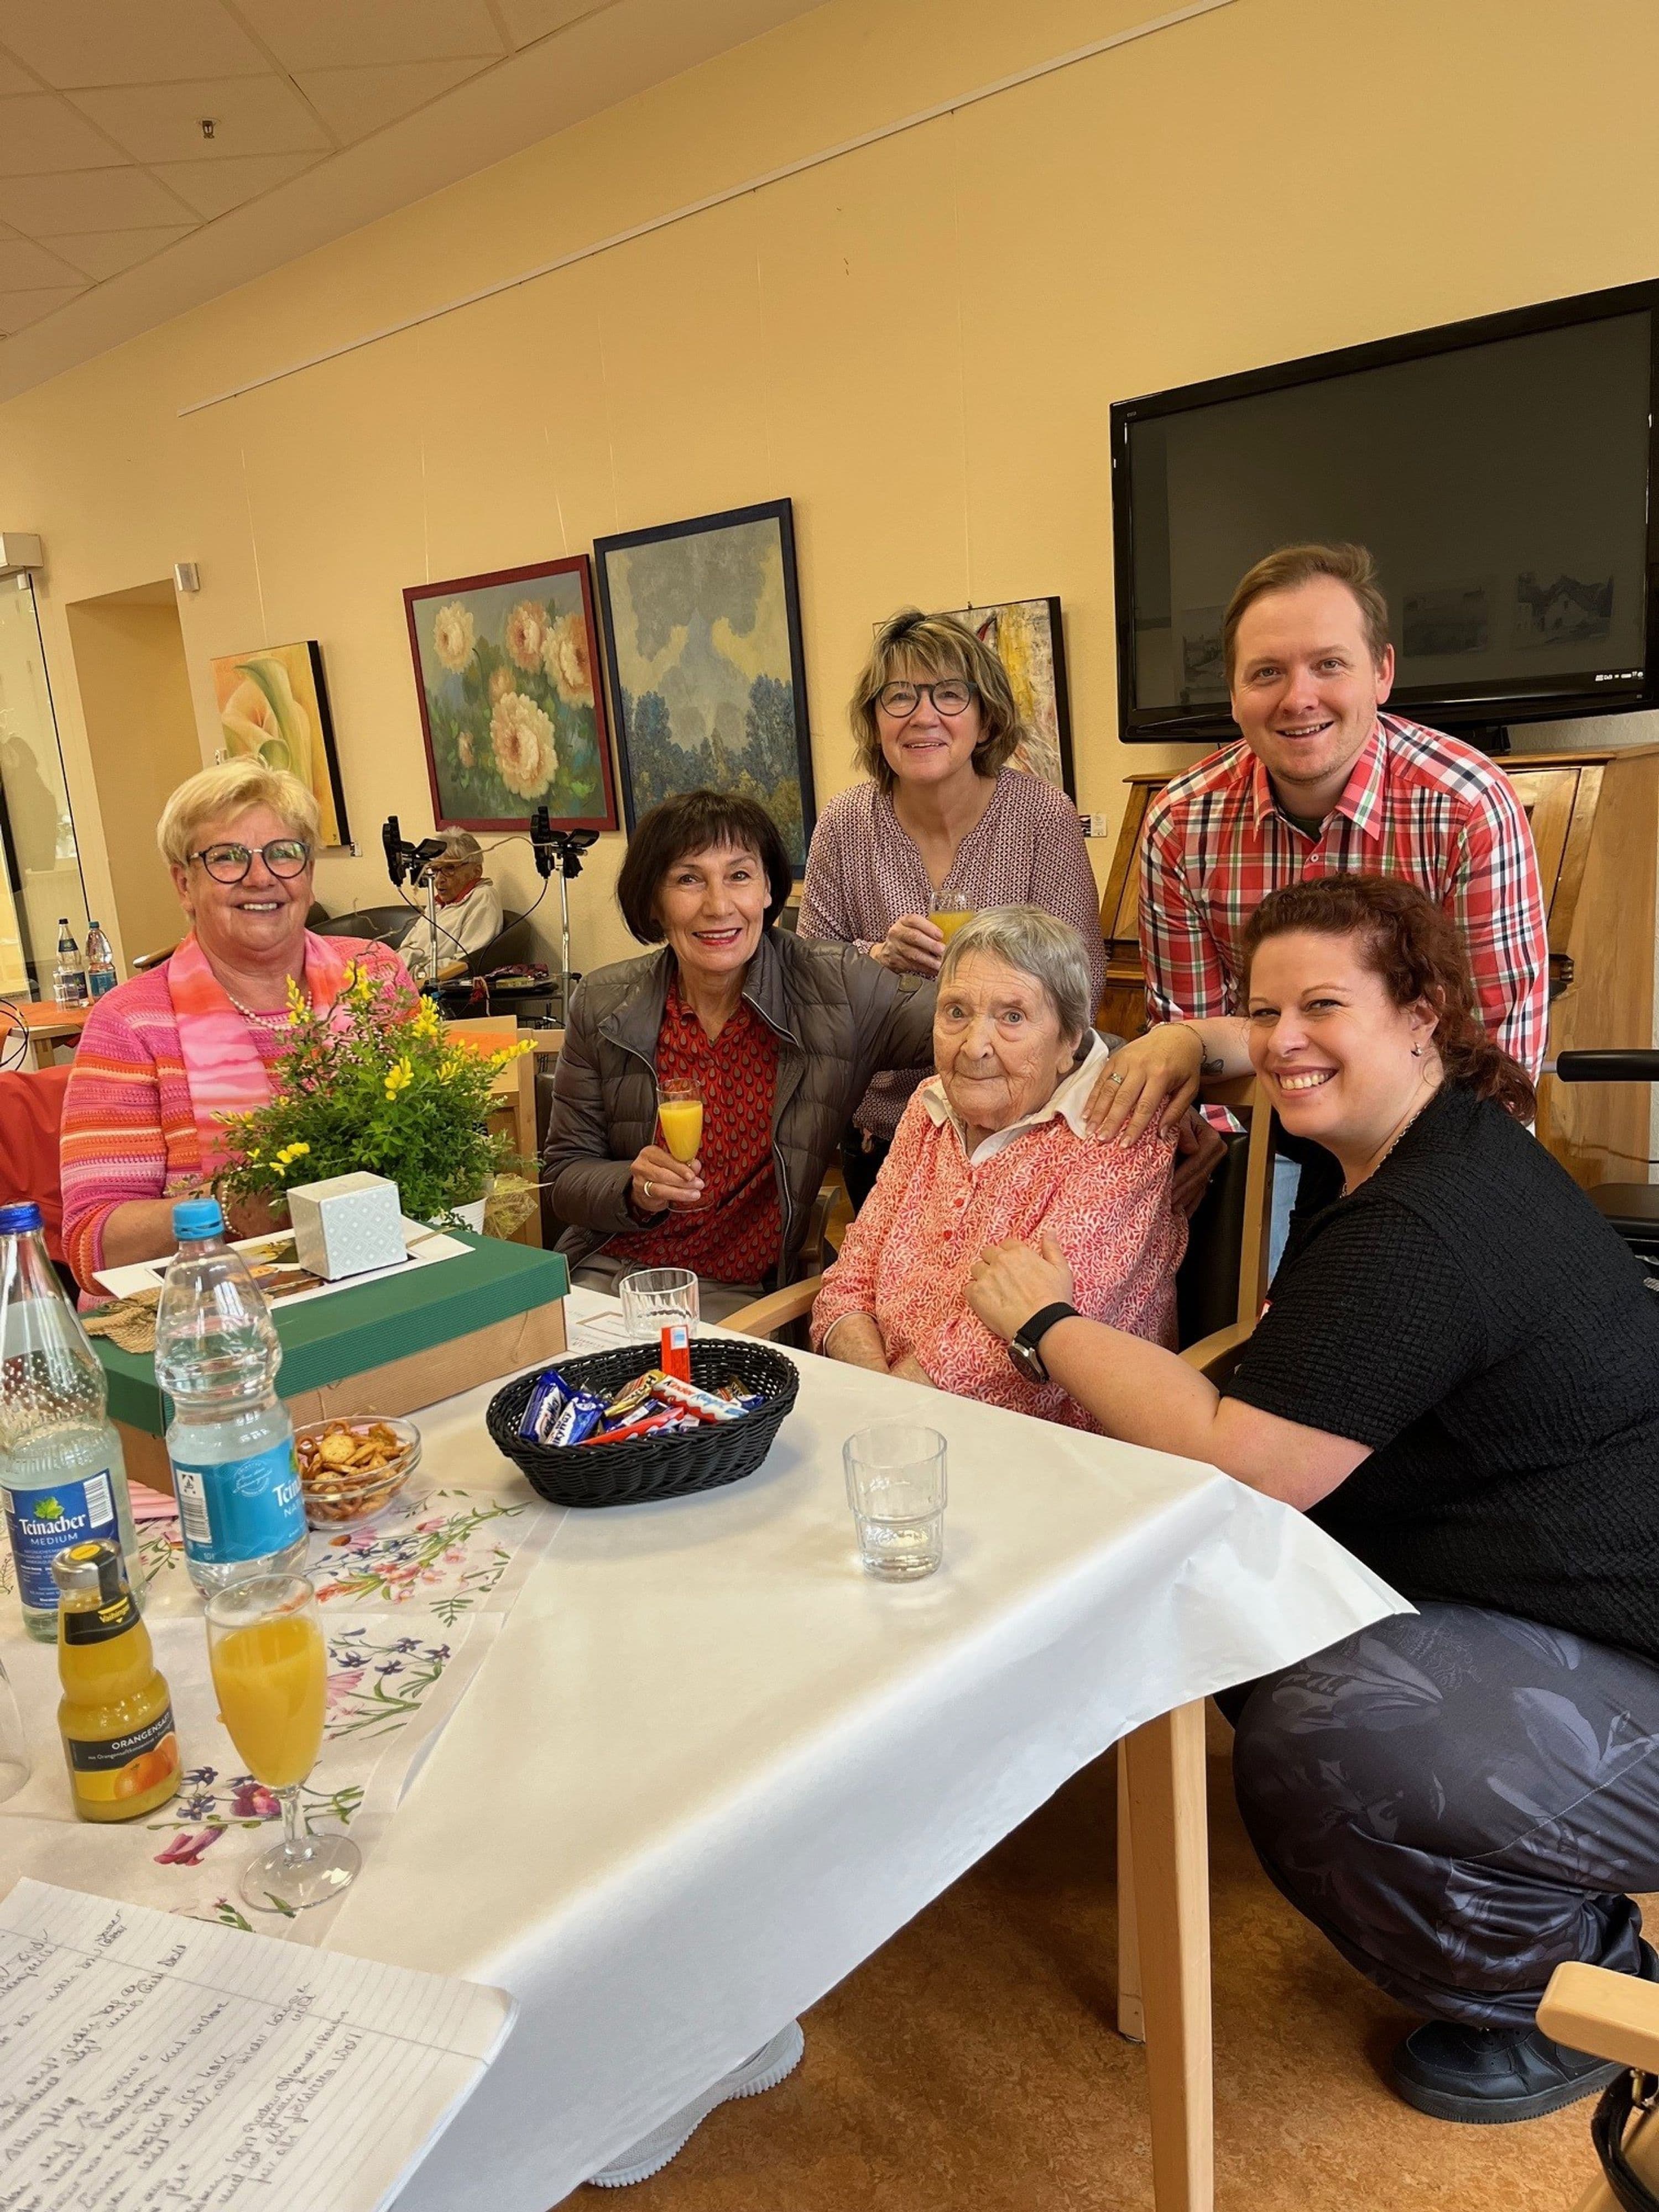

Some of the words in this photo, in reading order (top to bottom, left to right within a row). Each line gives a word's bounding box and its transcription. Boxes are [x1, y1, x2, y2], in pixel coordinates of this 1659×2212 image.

[19, 1513, 86, 1536] Teinacher
[30, 1532, 78, 1547] MEDIUM
[111, 1712, 171, 1751] ORANGENSAFT
